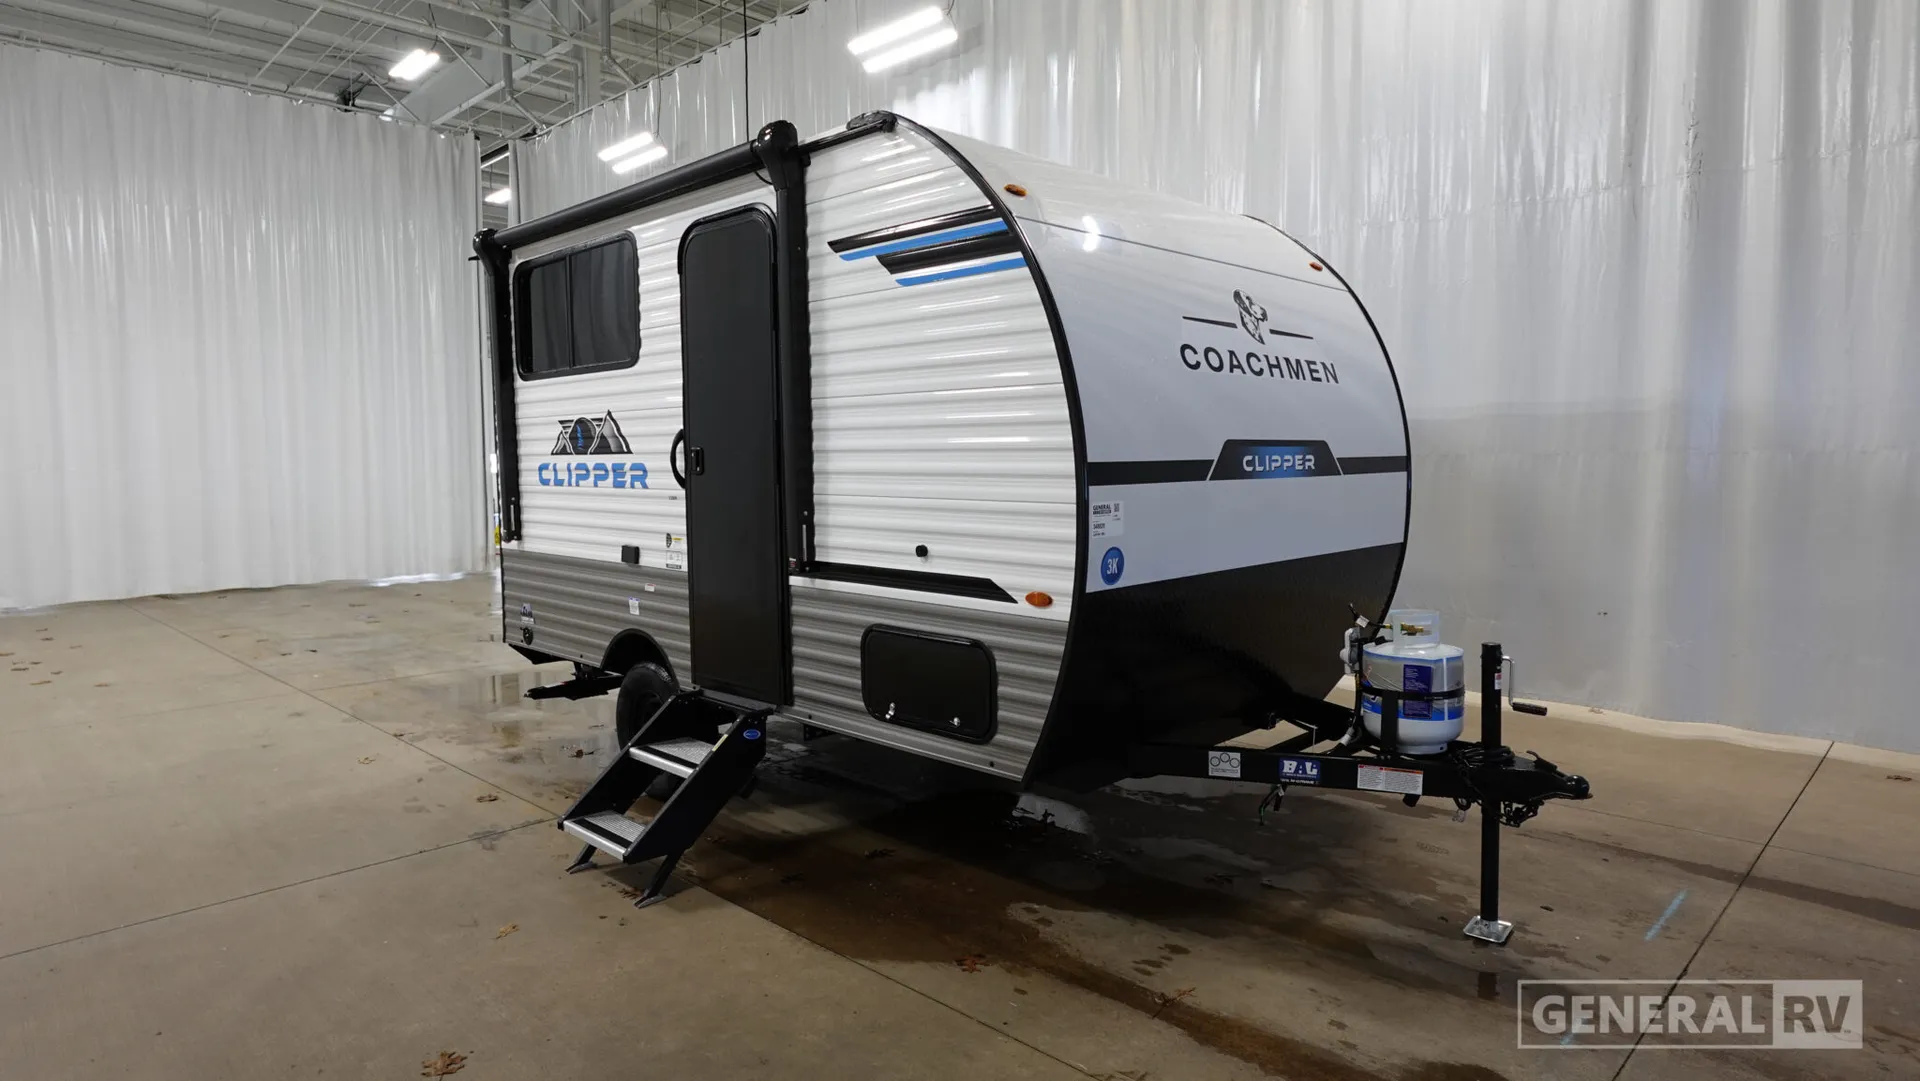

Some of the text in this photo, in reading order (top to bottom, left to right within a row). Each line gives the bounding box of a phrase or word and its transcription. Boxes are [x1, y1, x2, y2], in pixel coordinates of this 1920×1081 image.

[1180, 343, 1339, 384] COACHMEN
[1242, 455, 1316, 472] CLIPPER
[538, 463, 650, 489] CLIPPER
[1107, 558, 1119, 574] 3K
